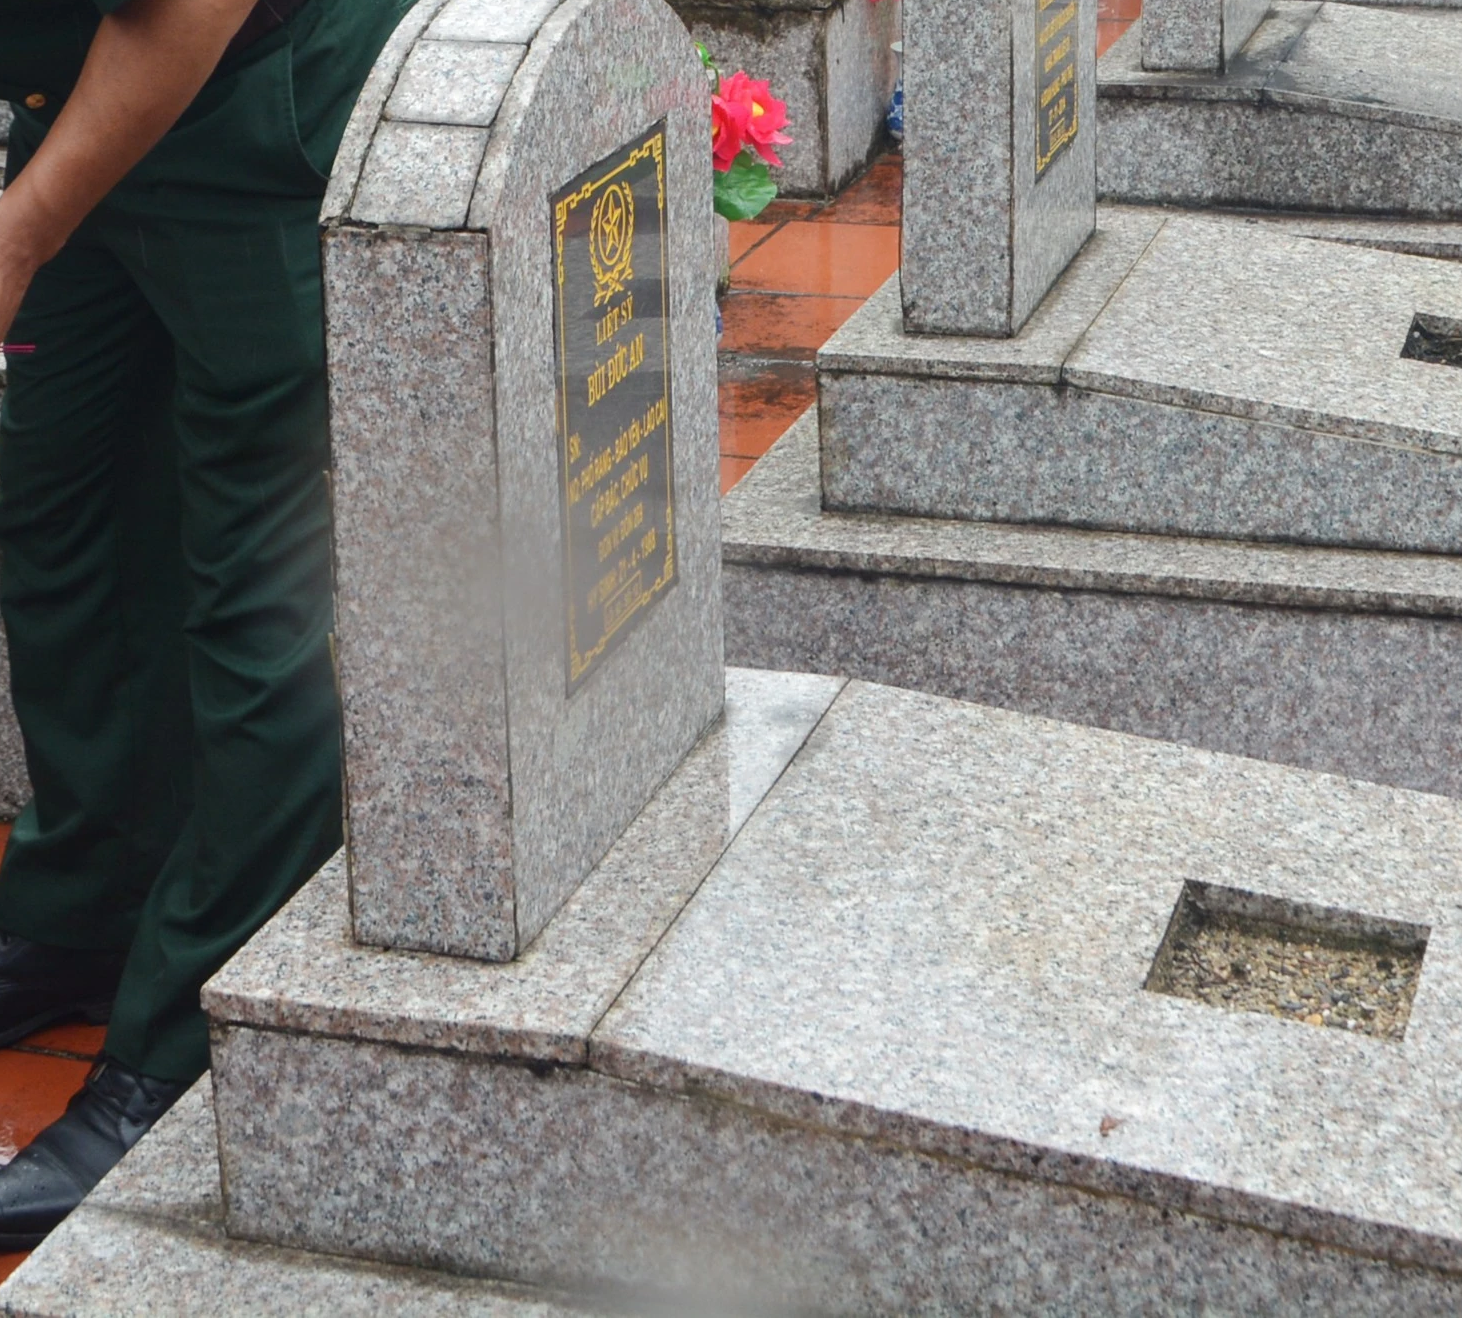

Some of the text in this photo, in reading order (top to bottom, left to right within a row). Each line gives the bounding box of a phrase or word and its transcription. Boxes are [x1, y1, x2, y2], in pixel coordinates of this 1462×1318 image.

[595, 305, 619, 346] LIỆT
[587, 332, 645, 408] BÙI ĐỨC AN
